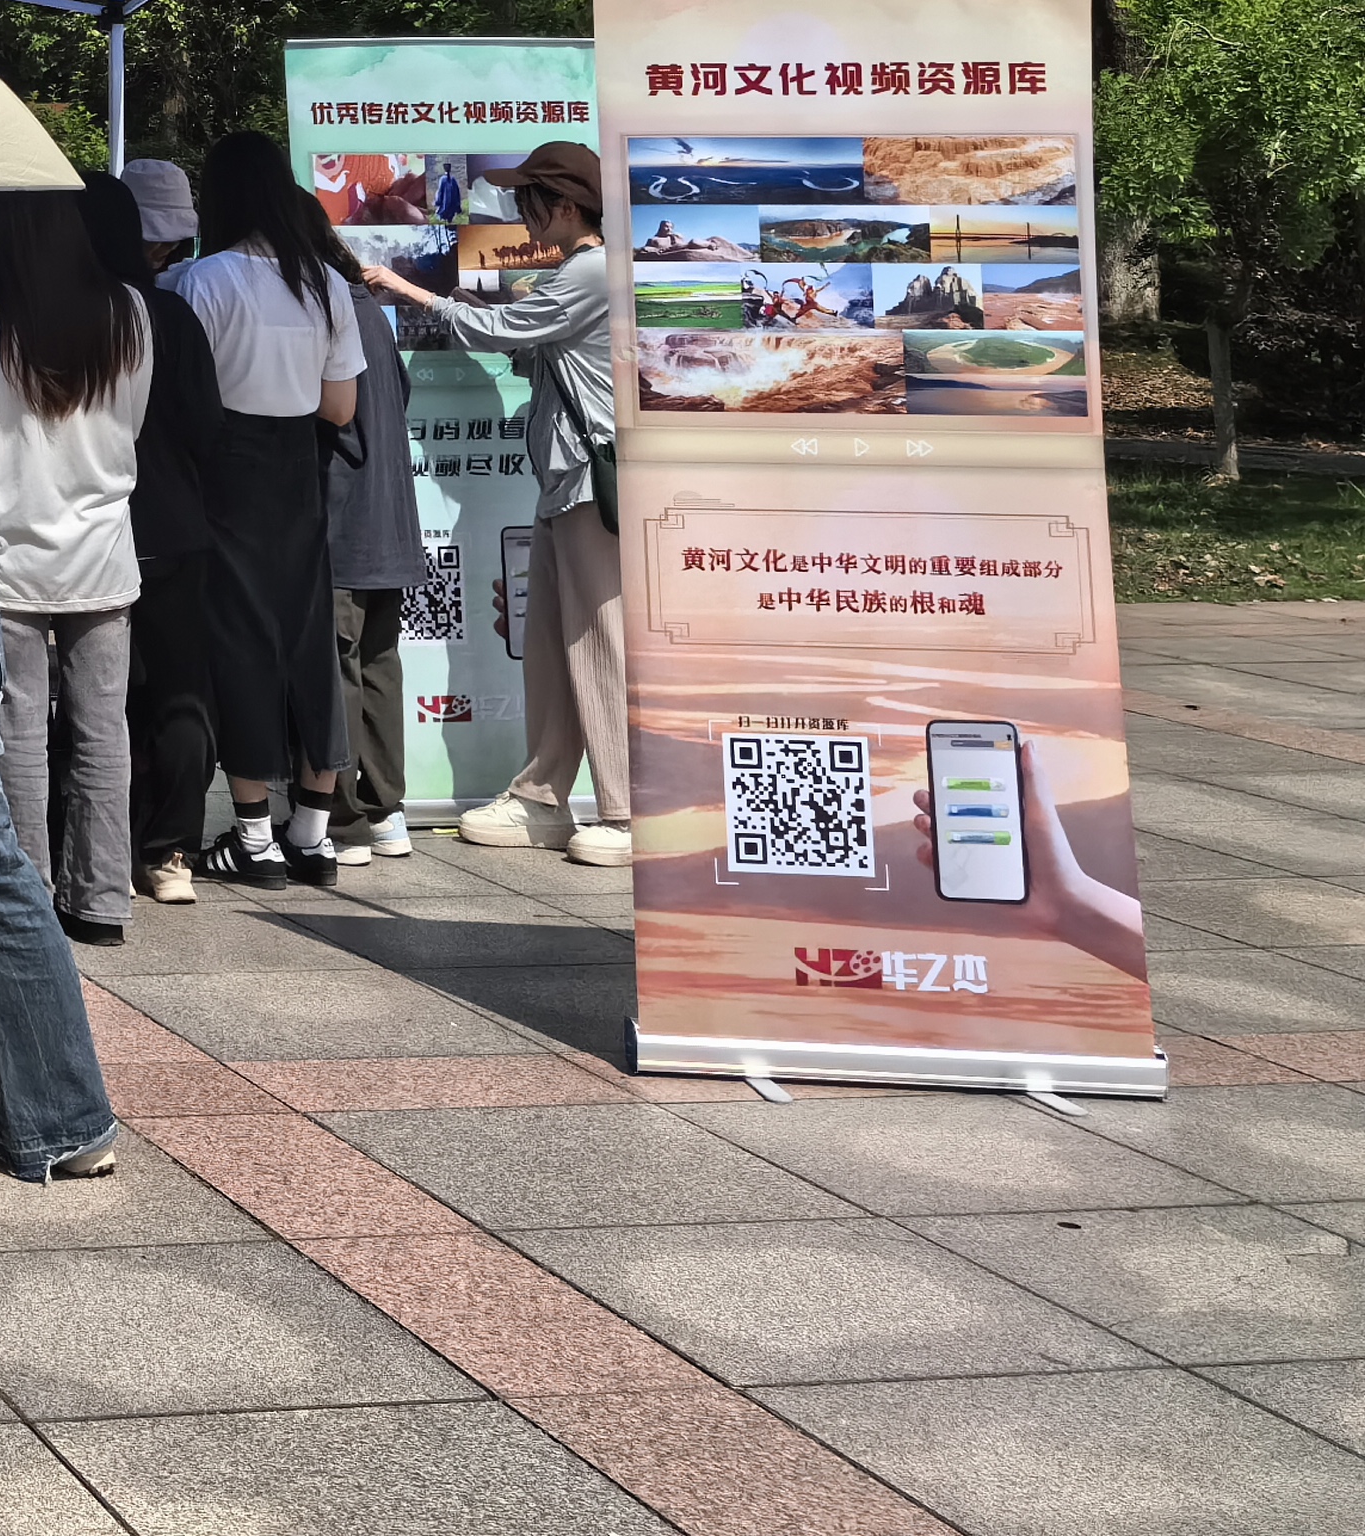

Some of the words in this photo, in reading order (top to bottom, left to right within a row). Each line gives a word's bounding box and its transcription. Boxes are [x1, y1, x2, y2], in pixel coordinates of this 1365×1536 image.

[645, 61, 1048, 96] 黄河文化视频资源库
[310, 101, 590, 125] 优秀传统文化视频资源库
[681, 547, 1064, 580] 黄河文化是中华文明的重要组成部分
[757, 587, 986, 617] 是中华民族的根和魂
